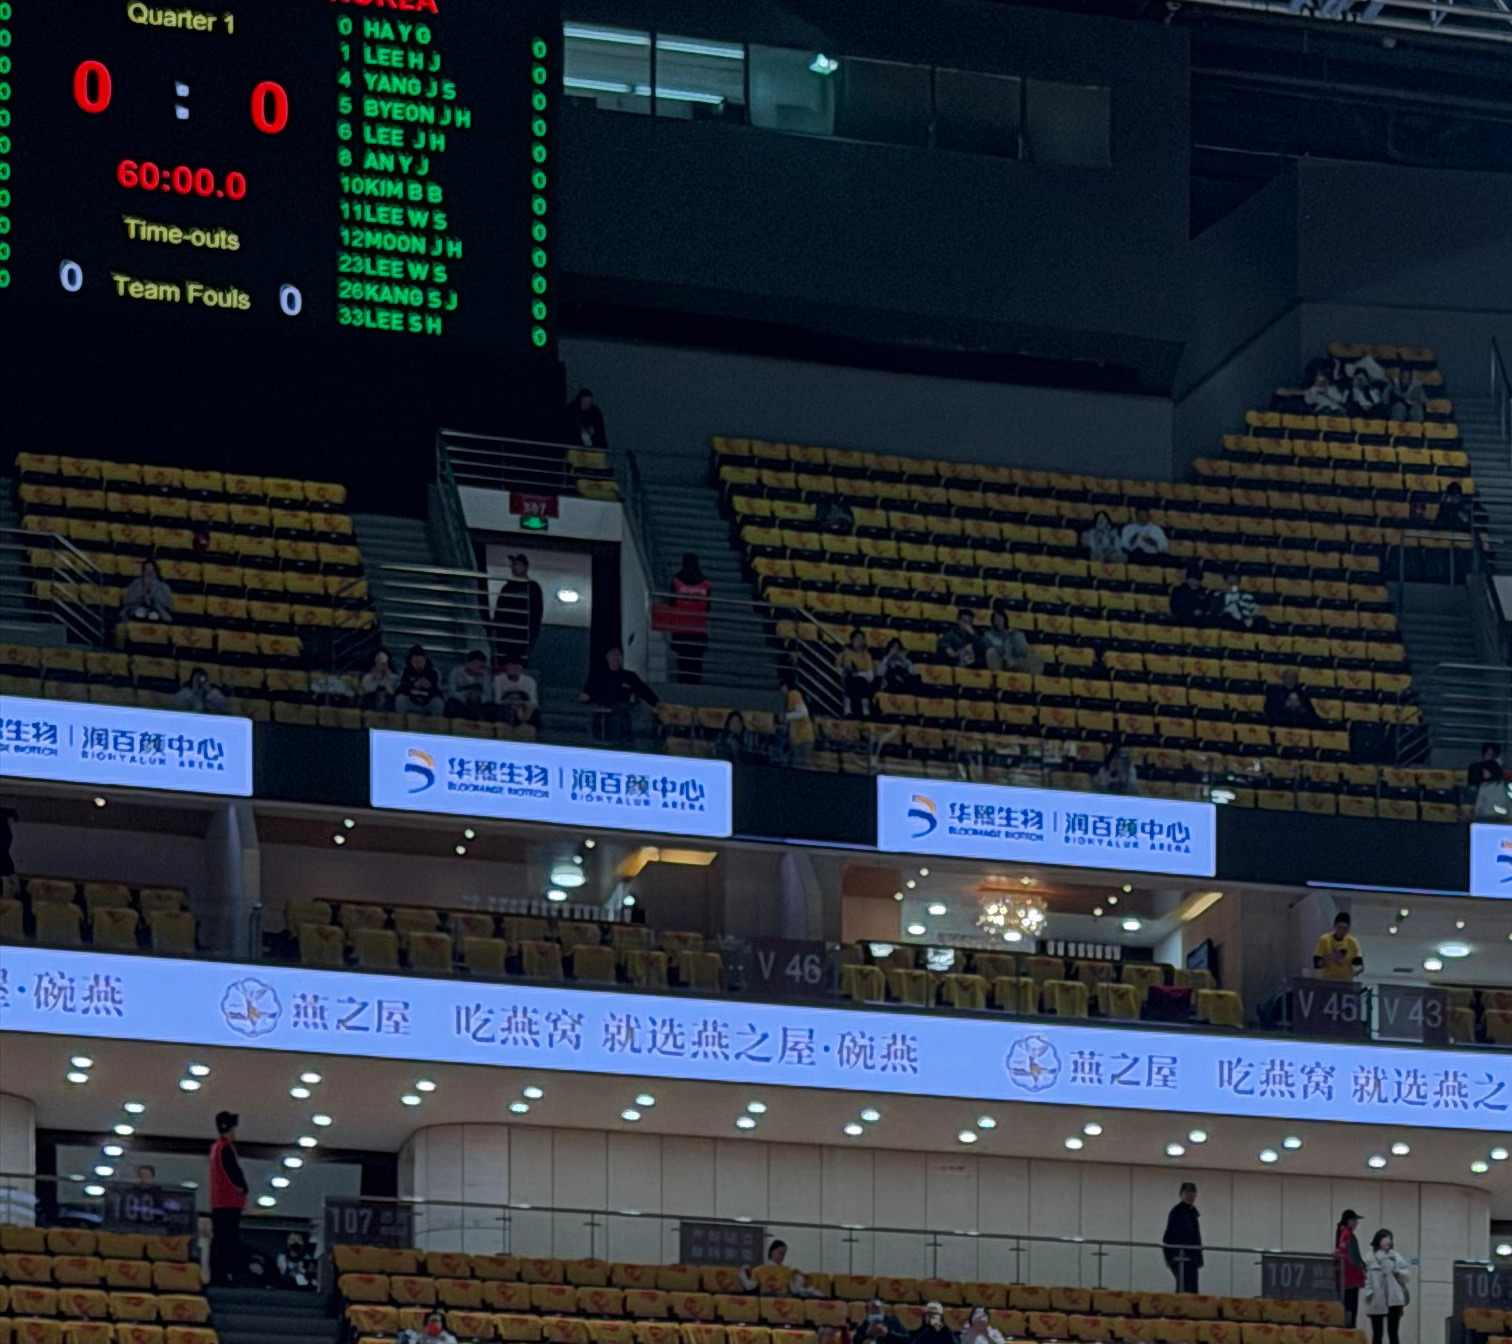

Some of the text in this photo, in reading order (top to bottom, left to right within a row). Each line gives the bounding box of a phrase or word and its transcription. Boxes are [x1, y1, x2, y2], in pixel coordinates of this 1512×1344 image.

[127, 2, 234, 34] Quarter 1
[338, 17, 547, 58] 0 HA Y O 0
[341, 43, 547, 84] 1 LEE H J 0
[74, 60, 288, 134] 0 0
[338, 70, 547, 110] 4 YANG J S 0
[338, 96, 547, 137] 5 BYEON J H 0
[363, 124, 405, 147] LEE
[413, 131, 426, 149] J
[429, 132, 446, 152] H
[532, 145, 547, 163] 0
[117, 159, 246, 200] 60:00.0
[363, 151, 395, 172] AN
[398, 155, 413, 174] Y
[416, 157, 429, 176] J
[532, 171, 547, 189] 0
[407, 182, 423, 201] B
[427, 184, 443, 204] B
[532, 198, 547, 216] 0
[122, 216, 240, 251] Time-outs
[408, 209, 429, 228] W
[433, 211, 447, 230] S
[532, 223, 547, 241] 0
[430, 239, 443, 256] J
[446, 240, 463, 258] H
[532, 250, 547, 268] 0
[60, 260, 83, 292] 0
[112, 274, 251, 310] Team Fouls
[408, 261, 429, 280] W
[433, 264, 447, 283] S
[532, 276, 547, 294] 0
[280, 284, 302, 316] 0
[427, 290, 442, 309] S
[445, 292, 458, 311] J
[532, 302, 547, 320] 0
[408, 315, 423, 333] S
[425, 316, 442, 336] H
[532, 328, 547, 346] 0
[0, 968, 123, 1017] ·碗燕
[292, 992, 411, 1036] 燕之屋
[455, 1002, 585, 1051] 吃燕窝
[1070, 1050, 1178, 1089] 燕之屋
[1217, 1057, 1335, 1102] 吃燕窝
[1268, 1263, 1305, 1287] 107
[1466, 1273, 1501, 1298] 106
